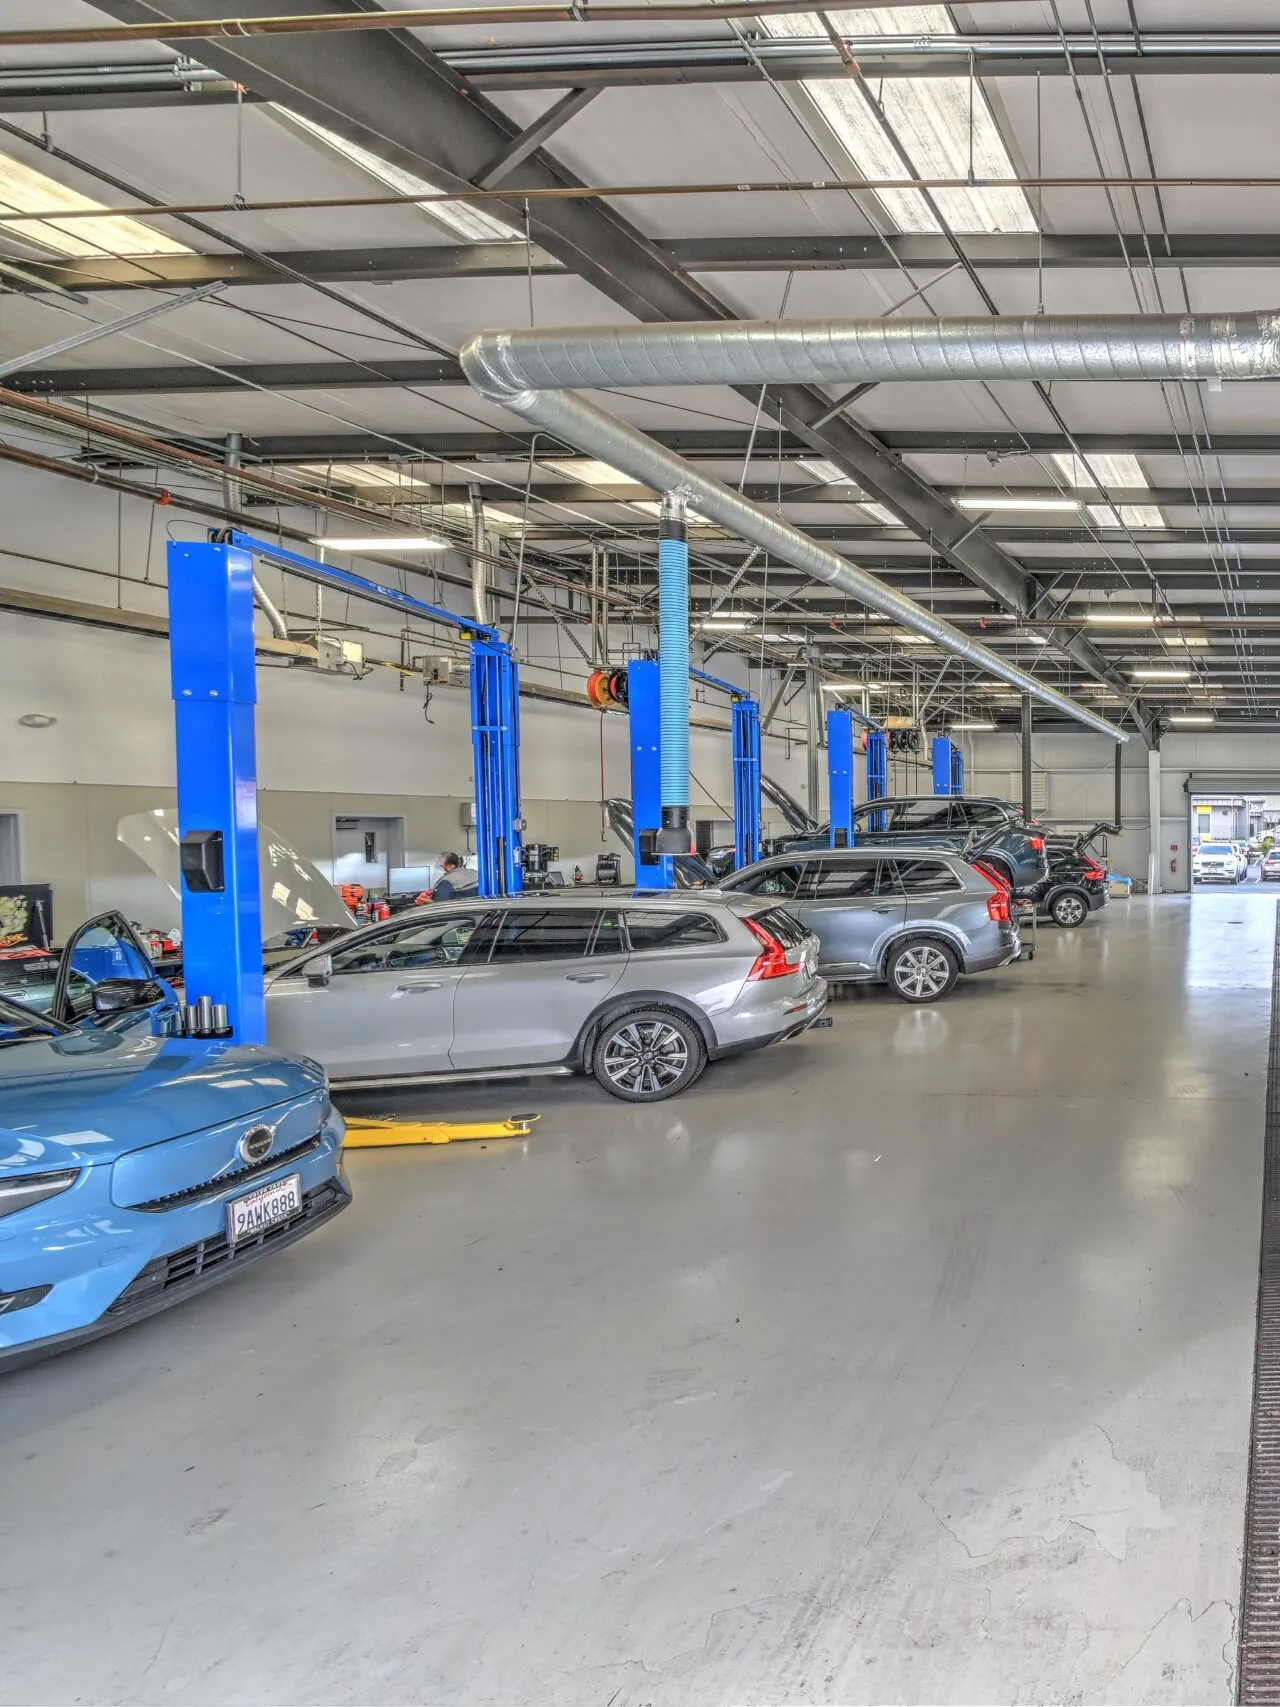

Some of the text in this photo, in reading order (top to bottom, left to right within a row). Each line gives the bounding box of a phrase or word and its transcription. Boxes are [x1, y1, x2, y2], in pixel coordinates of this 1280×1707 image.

[249, 1138, 272, 1149] VOLVO
[248, 1188, 268, 1199] VOLVO
[237, 1191, 295, 1234] 9AWK888
